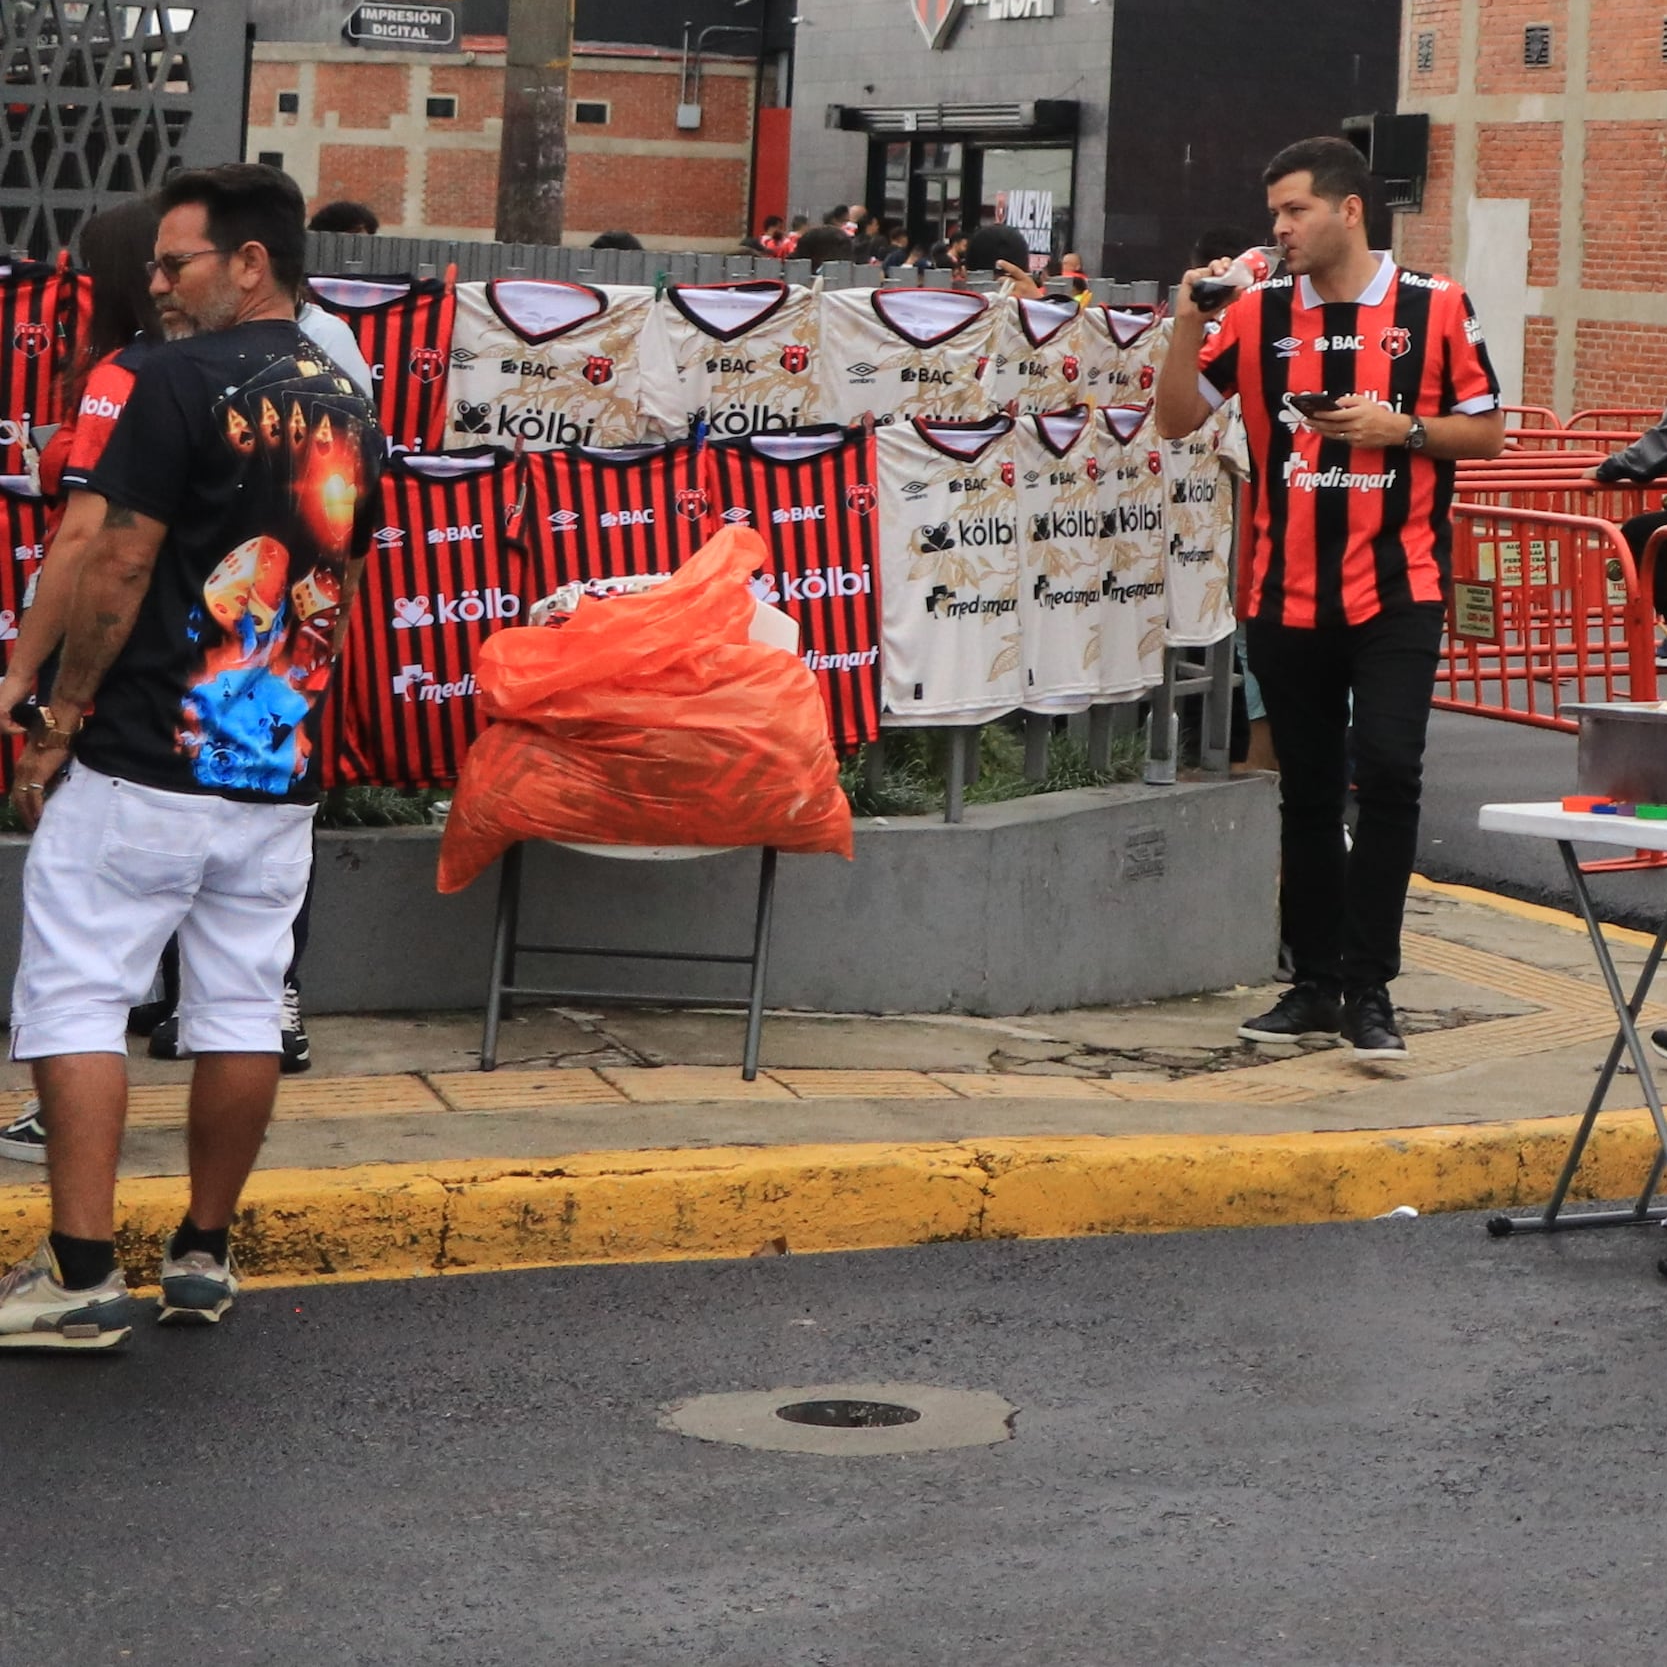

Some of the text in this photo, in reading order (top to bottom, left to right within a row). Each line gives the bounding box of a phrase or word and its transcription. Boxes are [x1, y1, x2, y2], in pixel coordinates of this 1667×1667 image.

[361, 7, 441, 25] IMPRESIÓN
[372, 24, 429, 38] DIGITAL
[1007, 190, 1052, 229] NUEVA
[1400, 271, 1450, 292] Mobil
[1332, 335, 1365, 351] BAC
[520, 361, 559, 381] BAC
[720, 359, 757, 374] BAC
[918, 368, 953, 385] BAC
[497, 405, 595, 446] kölbi
[964, 478, 988, 491] BAC
[1295, 466, 1396, 493] medismart
[619, 508, 654, 526] BAC
[791, 505, 826, 522] BAC
[447, 524, 483, 542] BAC
[783, 564, 872, 601] kölbi
[438, 587, 520, 624] kölb
